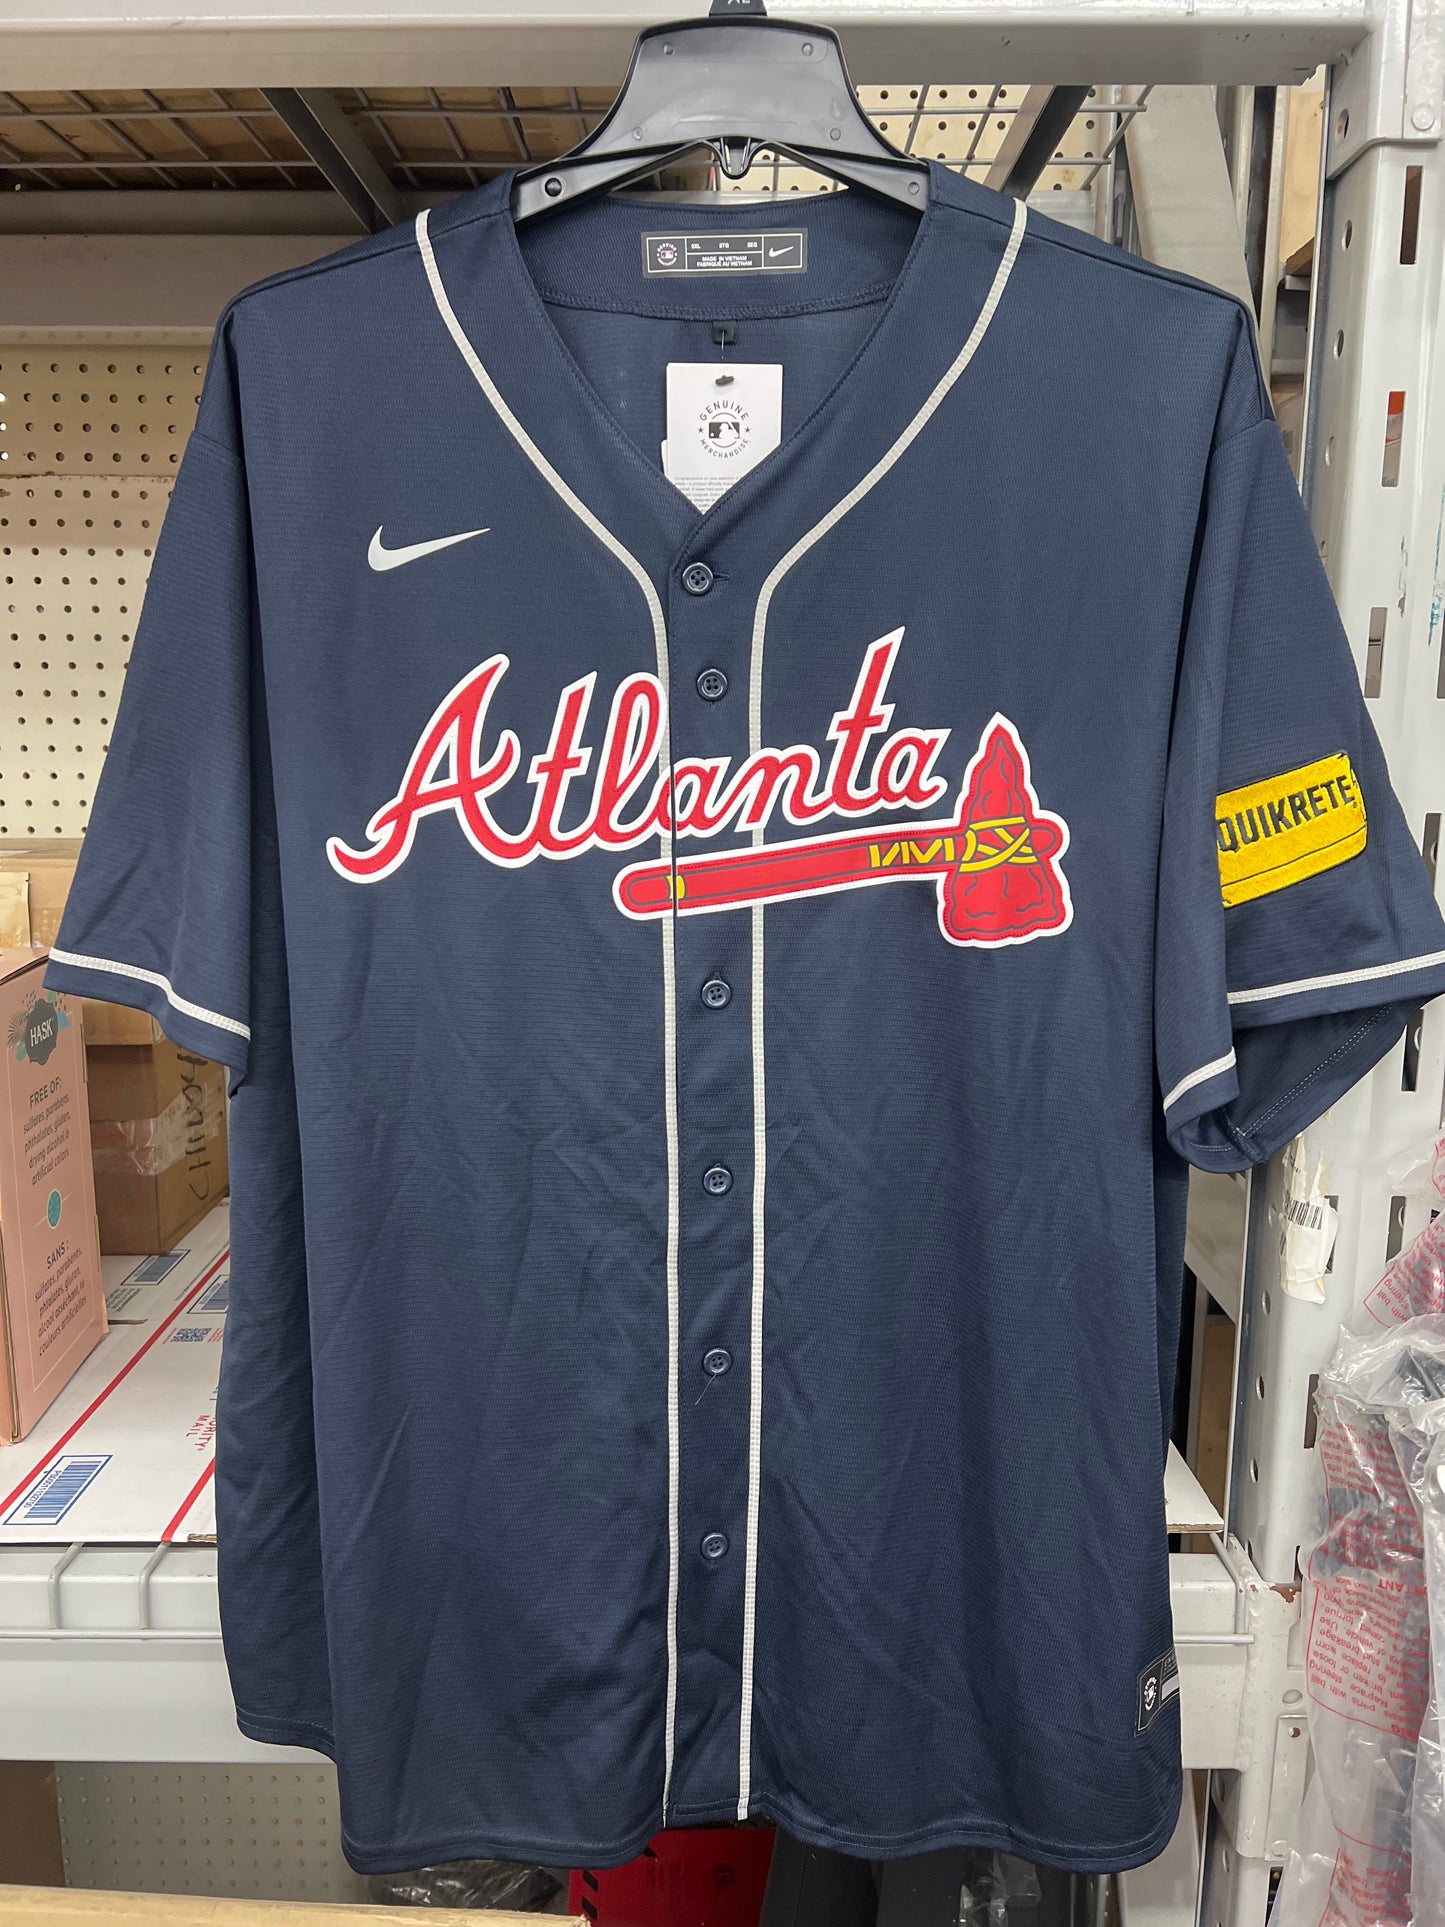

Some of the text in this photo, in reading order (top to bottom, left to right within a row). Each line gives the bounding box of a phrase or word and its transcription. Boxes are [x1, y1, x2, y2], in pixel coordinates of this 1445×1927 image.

[700, 400, 749, 421] GENUINE
[701, 439, 748, 459] MERCHANDISE
[327, 627, 952, 884] Atlanta
[1217, 775, 1356, 853] QUIKRETE
[30, 1019, 53, 1047] HASK
[29, 1085, 48, 1109] FREE
[47, 1131, 64, 1155] alcohol
[46, 1242, 65, 1269] SANS
[1377, 1290, 1408, 1322] with ball
[186, 1415, 210, 1437] MAIL
[195, 1417, 216, 1448] ORITY
[1320, 1616, 1338, 1631] Use
[1316, 1639, 1336, 1654] worn
[1313, 1651, 1336, 1669] loose
[1342, 1652, 1371, 1674] replace
[1363, 1652, 1380, 1666] stud
[1310, 1660, 1342, 1683] steering
[1311, 1674, 1326, 1688] ball
[1330, 1685, 1347, 1698] with
